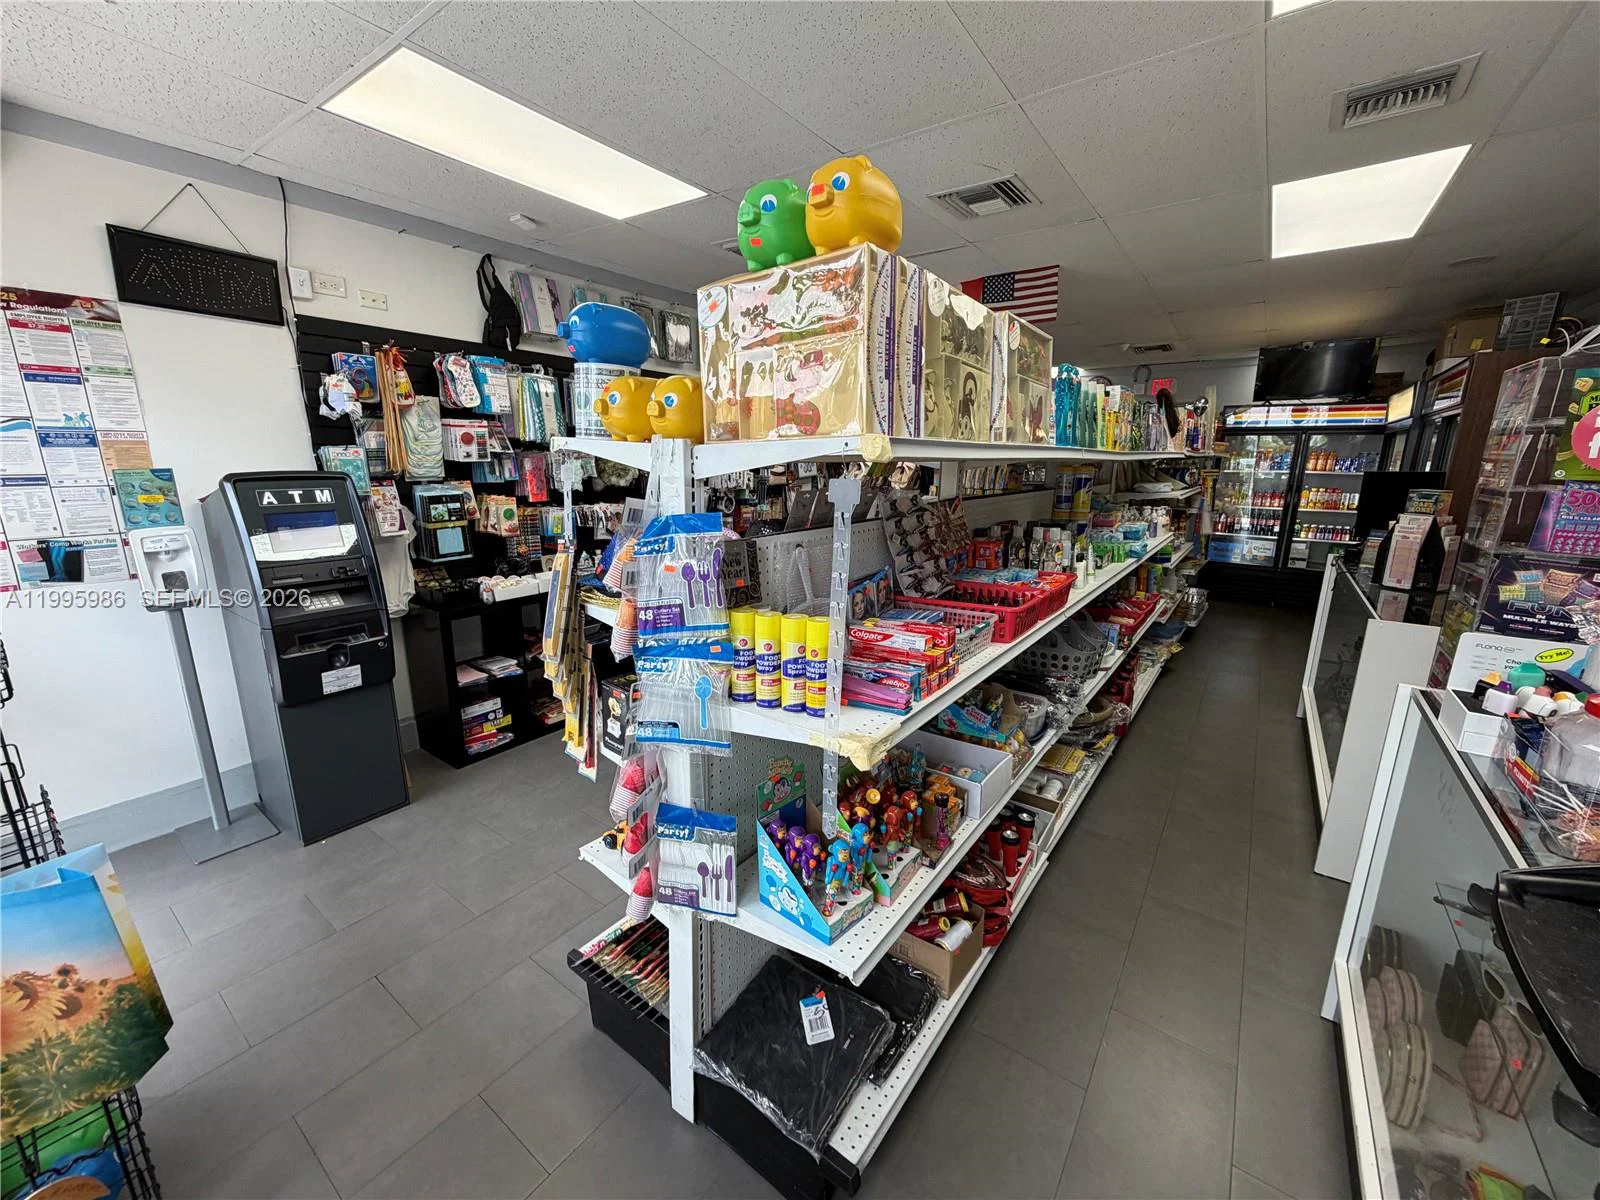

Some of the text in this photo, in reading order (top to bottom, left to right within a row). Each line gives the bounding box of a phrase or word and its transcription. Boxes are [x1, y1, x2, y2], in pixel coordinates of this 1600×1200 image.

[128, 253, 272, 306] ATM
[10, 301, 68, 315] Regulations
[876, 269, 891, 338] Ensemble
[905, 280, 918, 345] Ensemble
[876, 340, 884, 374] Bath
[904, 347, 912, 379] Bath
[877, 376, 886, 414] Piece
[639, 609, 654, 620] 48
[1503, 614, 1547, 624] MULTIPLE
[1549, 620, 1578, 629] WAYS
[850, 628, 883, 641] Colgate
[637, 660, 673, 671] Party!
[881, 678, 910, 690] Colgate
[657, 825, 690, 838] Party!
[659, 886, 673, 896] 48
